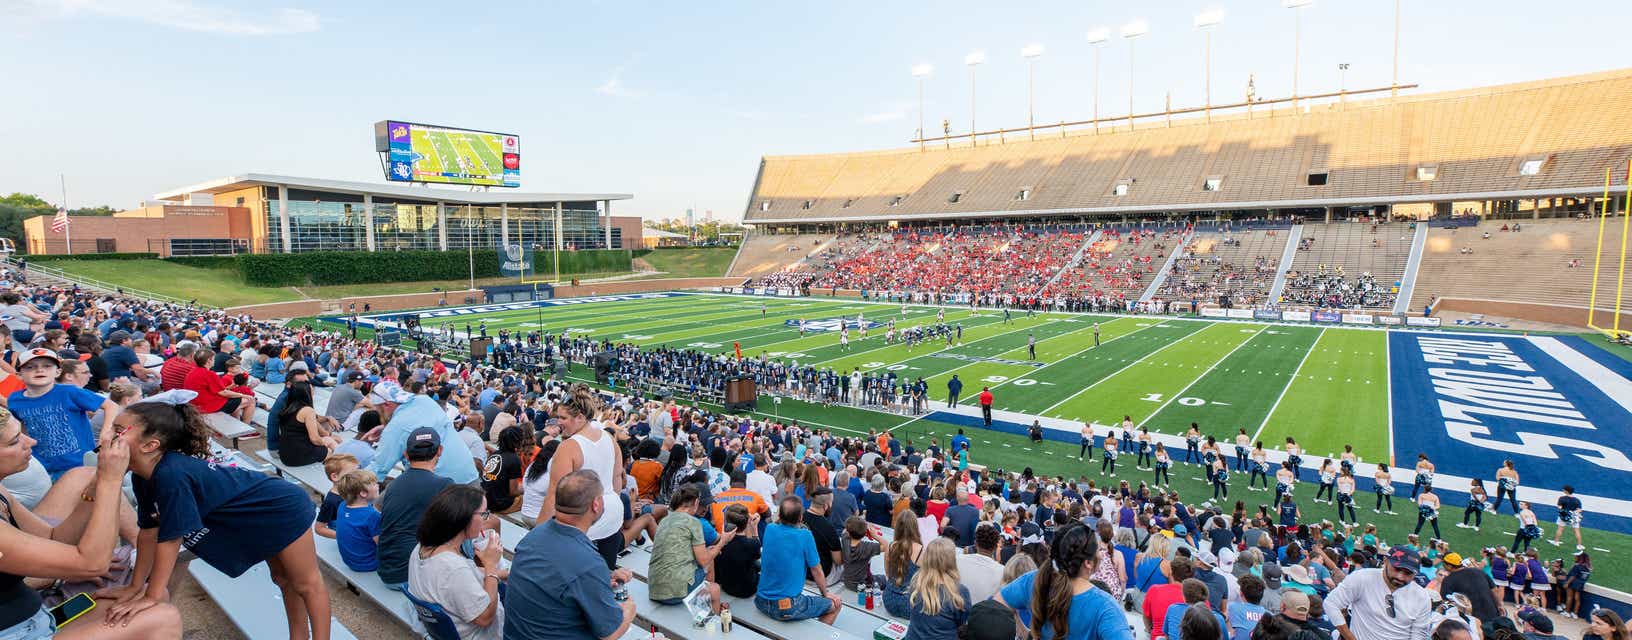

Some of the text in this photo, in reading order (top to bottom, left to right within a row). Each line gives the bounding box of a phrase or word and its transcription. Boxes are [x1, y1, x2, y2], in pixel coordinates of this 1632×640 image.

[1140, 392, 1207, 407] 10
[1417, 336, 1632, 472] RICE OWLS
